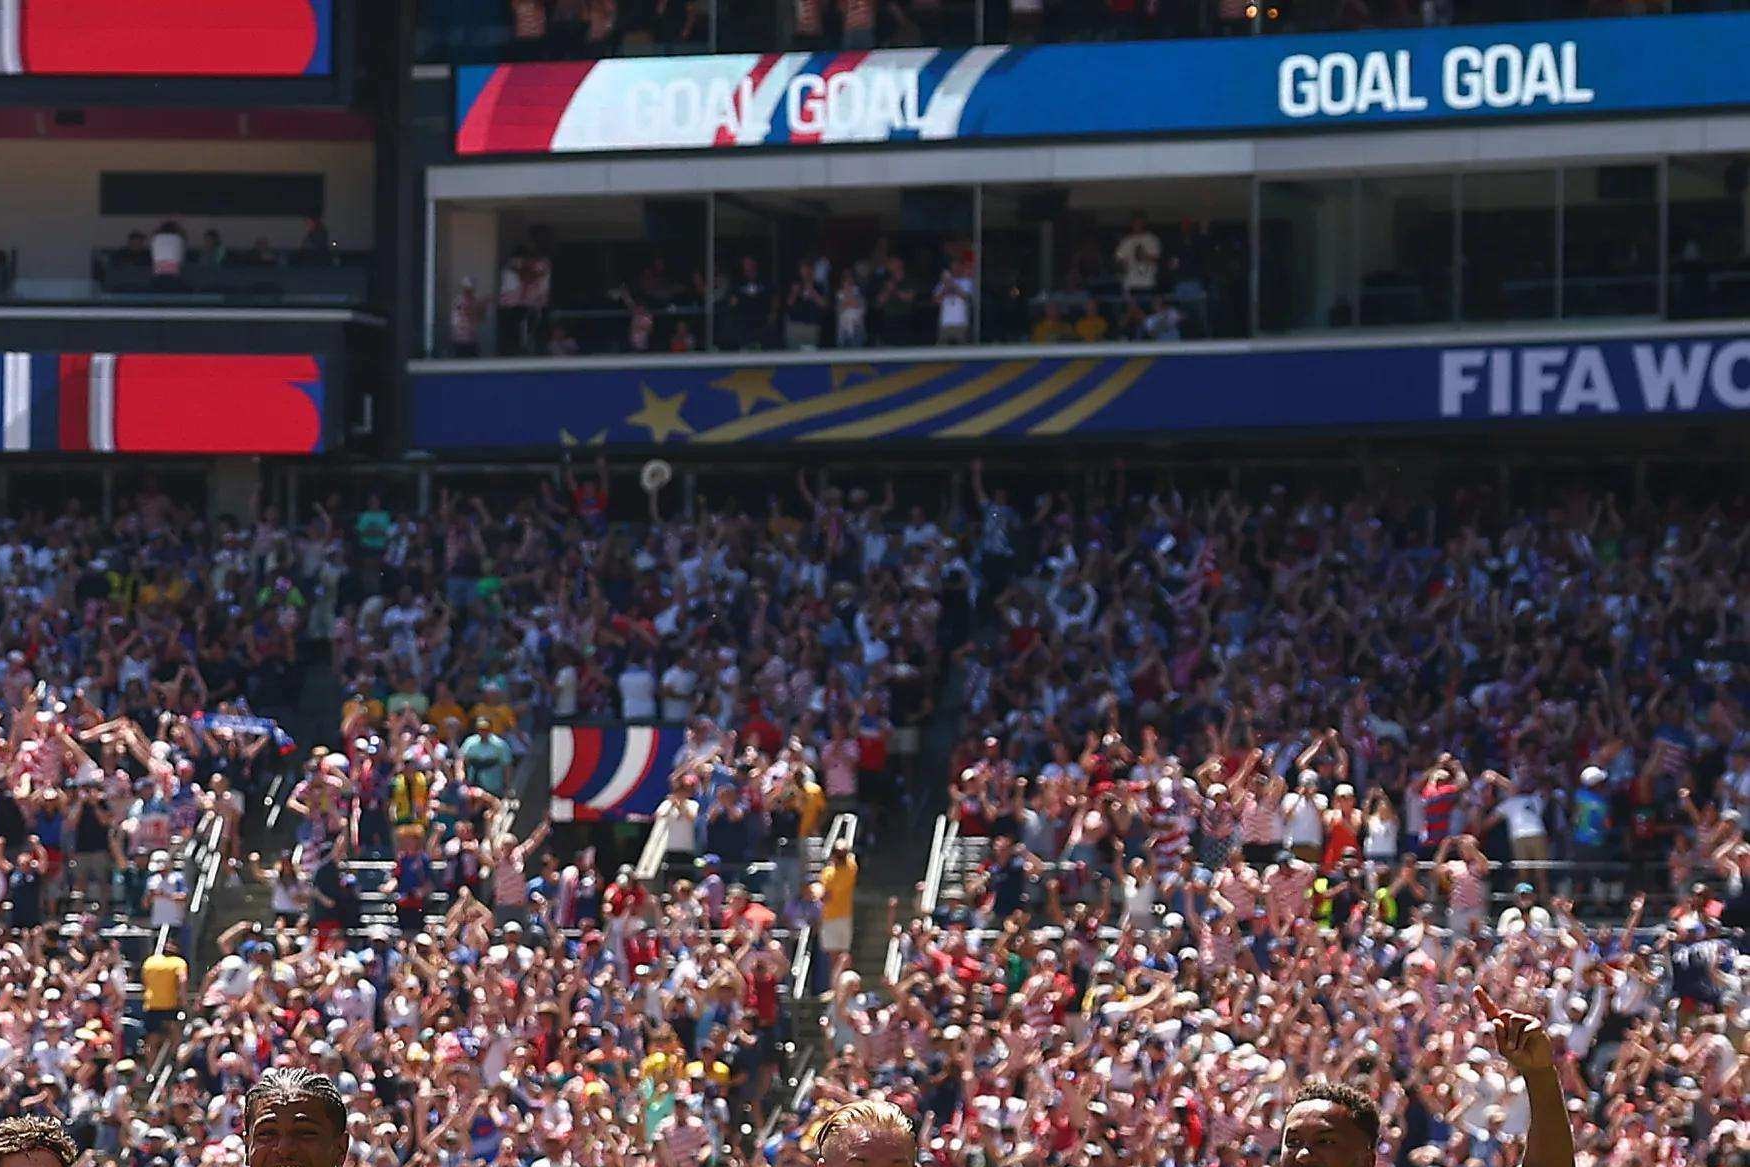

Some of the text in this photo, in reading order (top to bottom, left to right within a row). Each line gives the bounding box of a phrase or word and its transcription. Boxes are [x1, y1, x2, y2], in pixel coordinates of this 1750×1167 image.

[628, 67, 936, 137] GOAL GOAL
[1278, 40, 1595, 117] GOAL GOAL
[1439, 346, 1619, 417] FIFA
